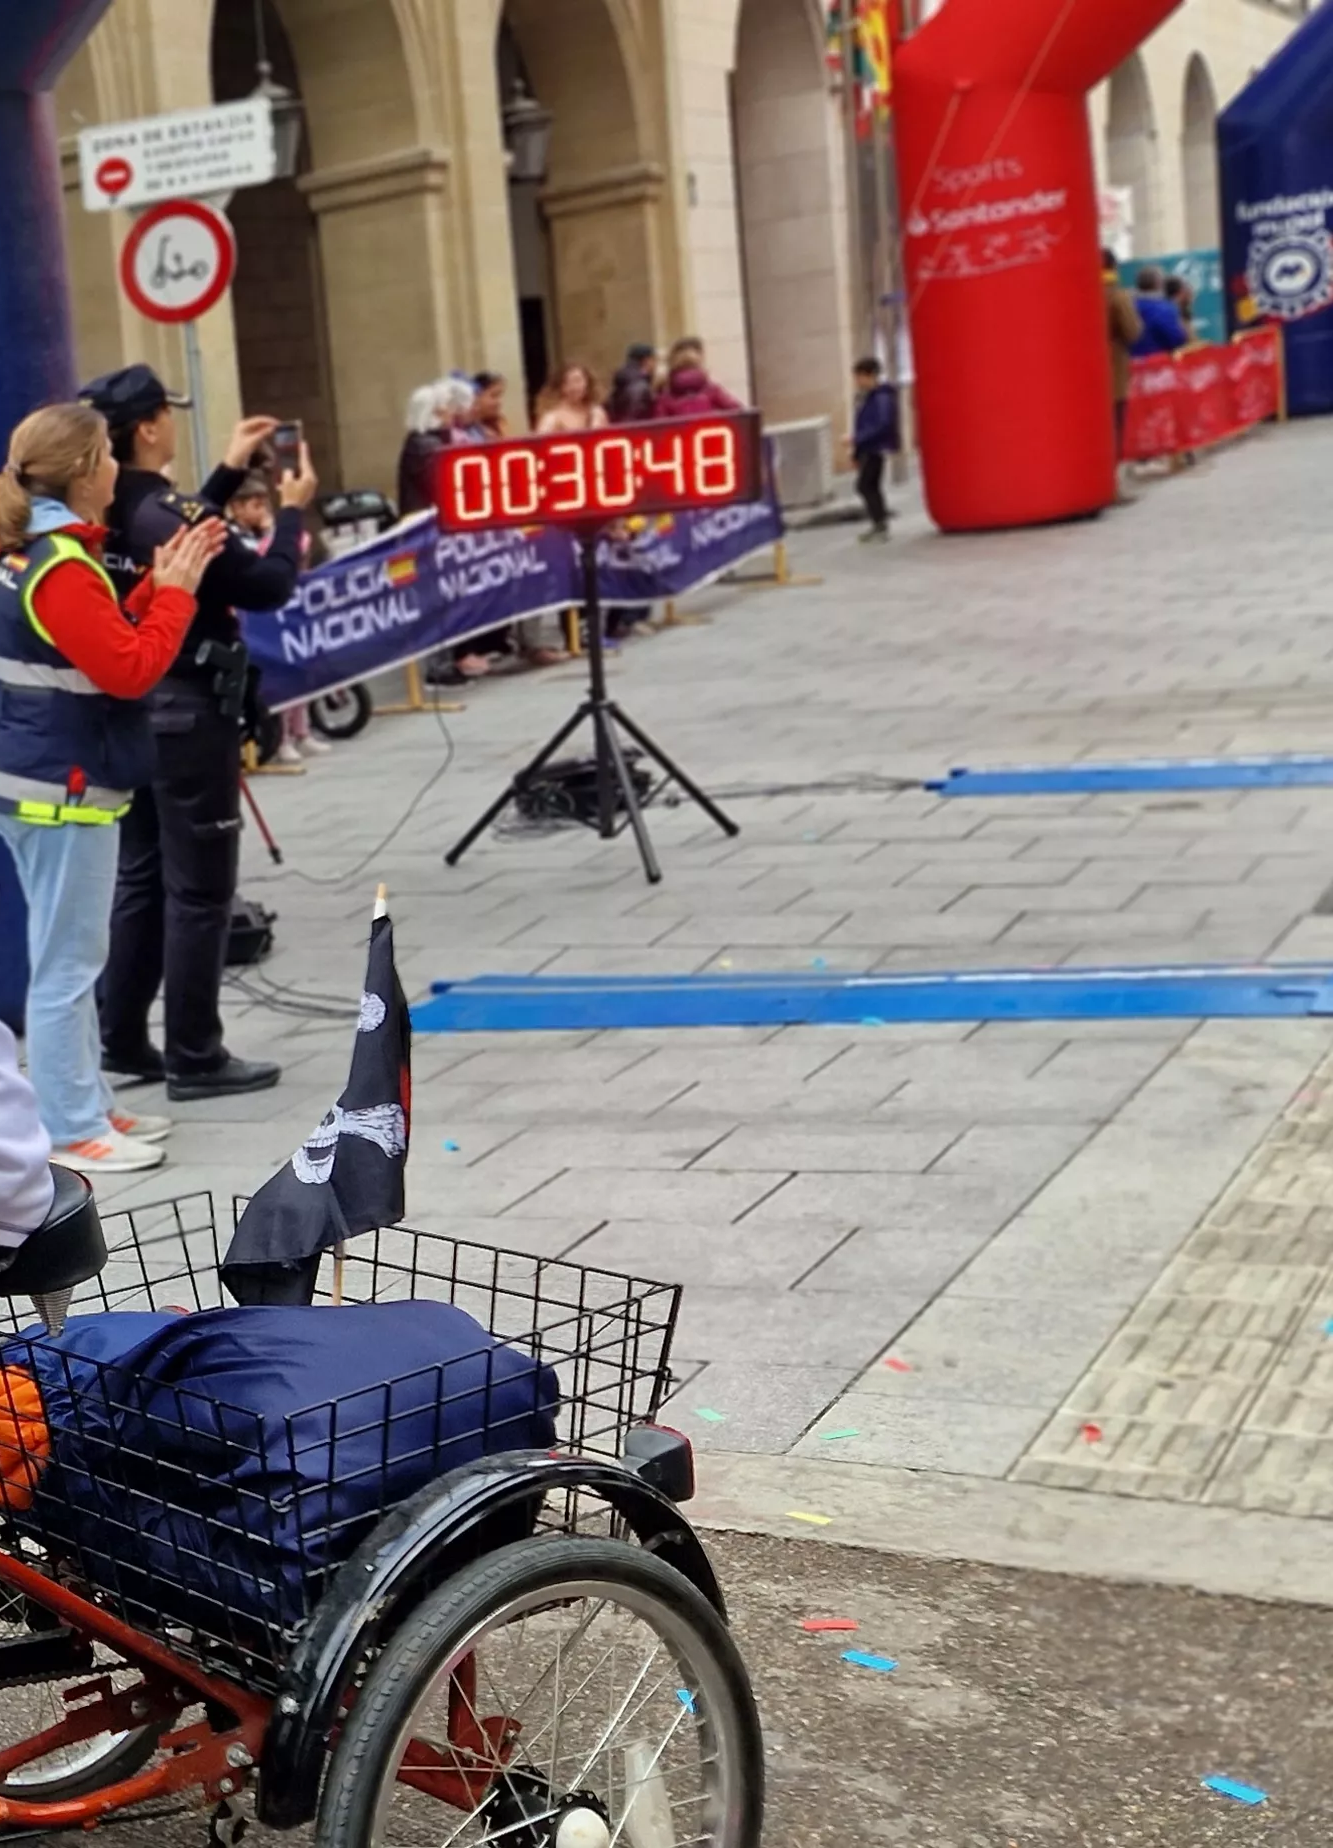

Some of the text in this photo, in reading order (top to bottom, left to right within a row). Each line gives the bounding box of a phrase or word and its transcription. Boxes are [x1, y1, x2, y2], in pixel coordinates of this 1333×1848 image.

[930, 187, 1067, 235] Santander
[453, 426, 736, 521] 00:30:48
[282, 591, 421, 664] NACIONAL
